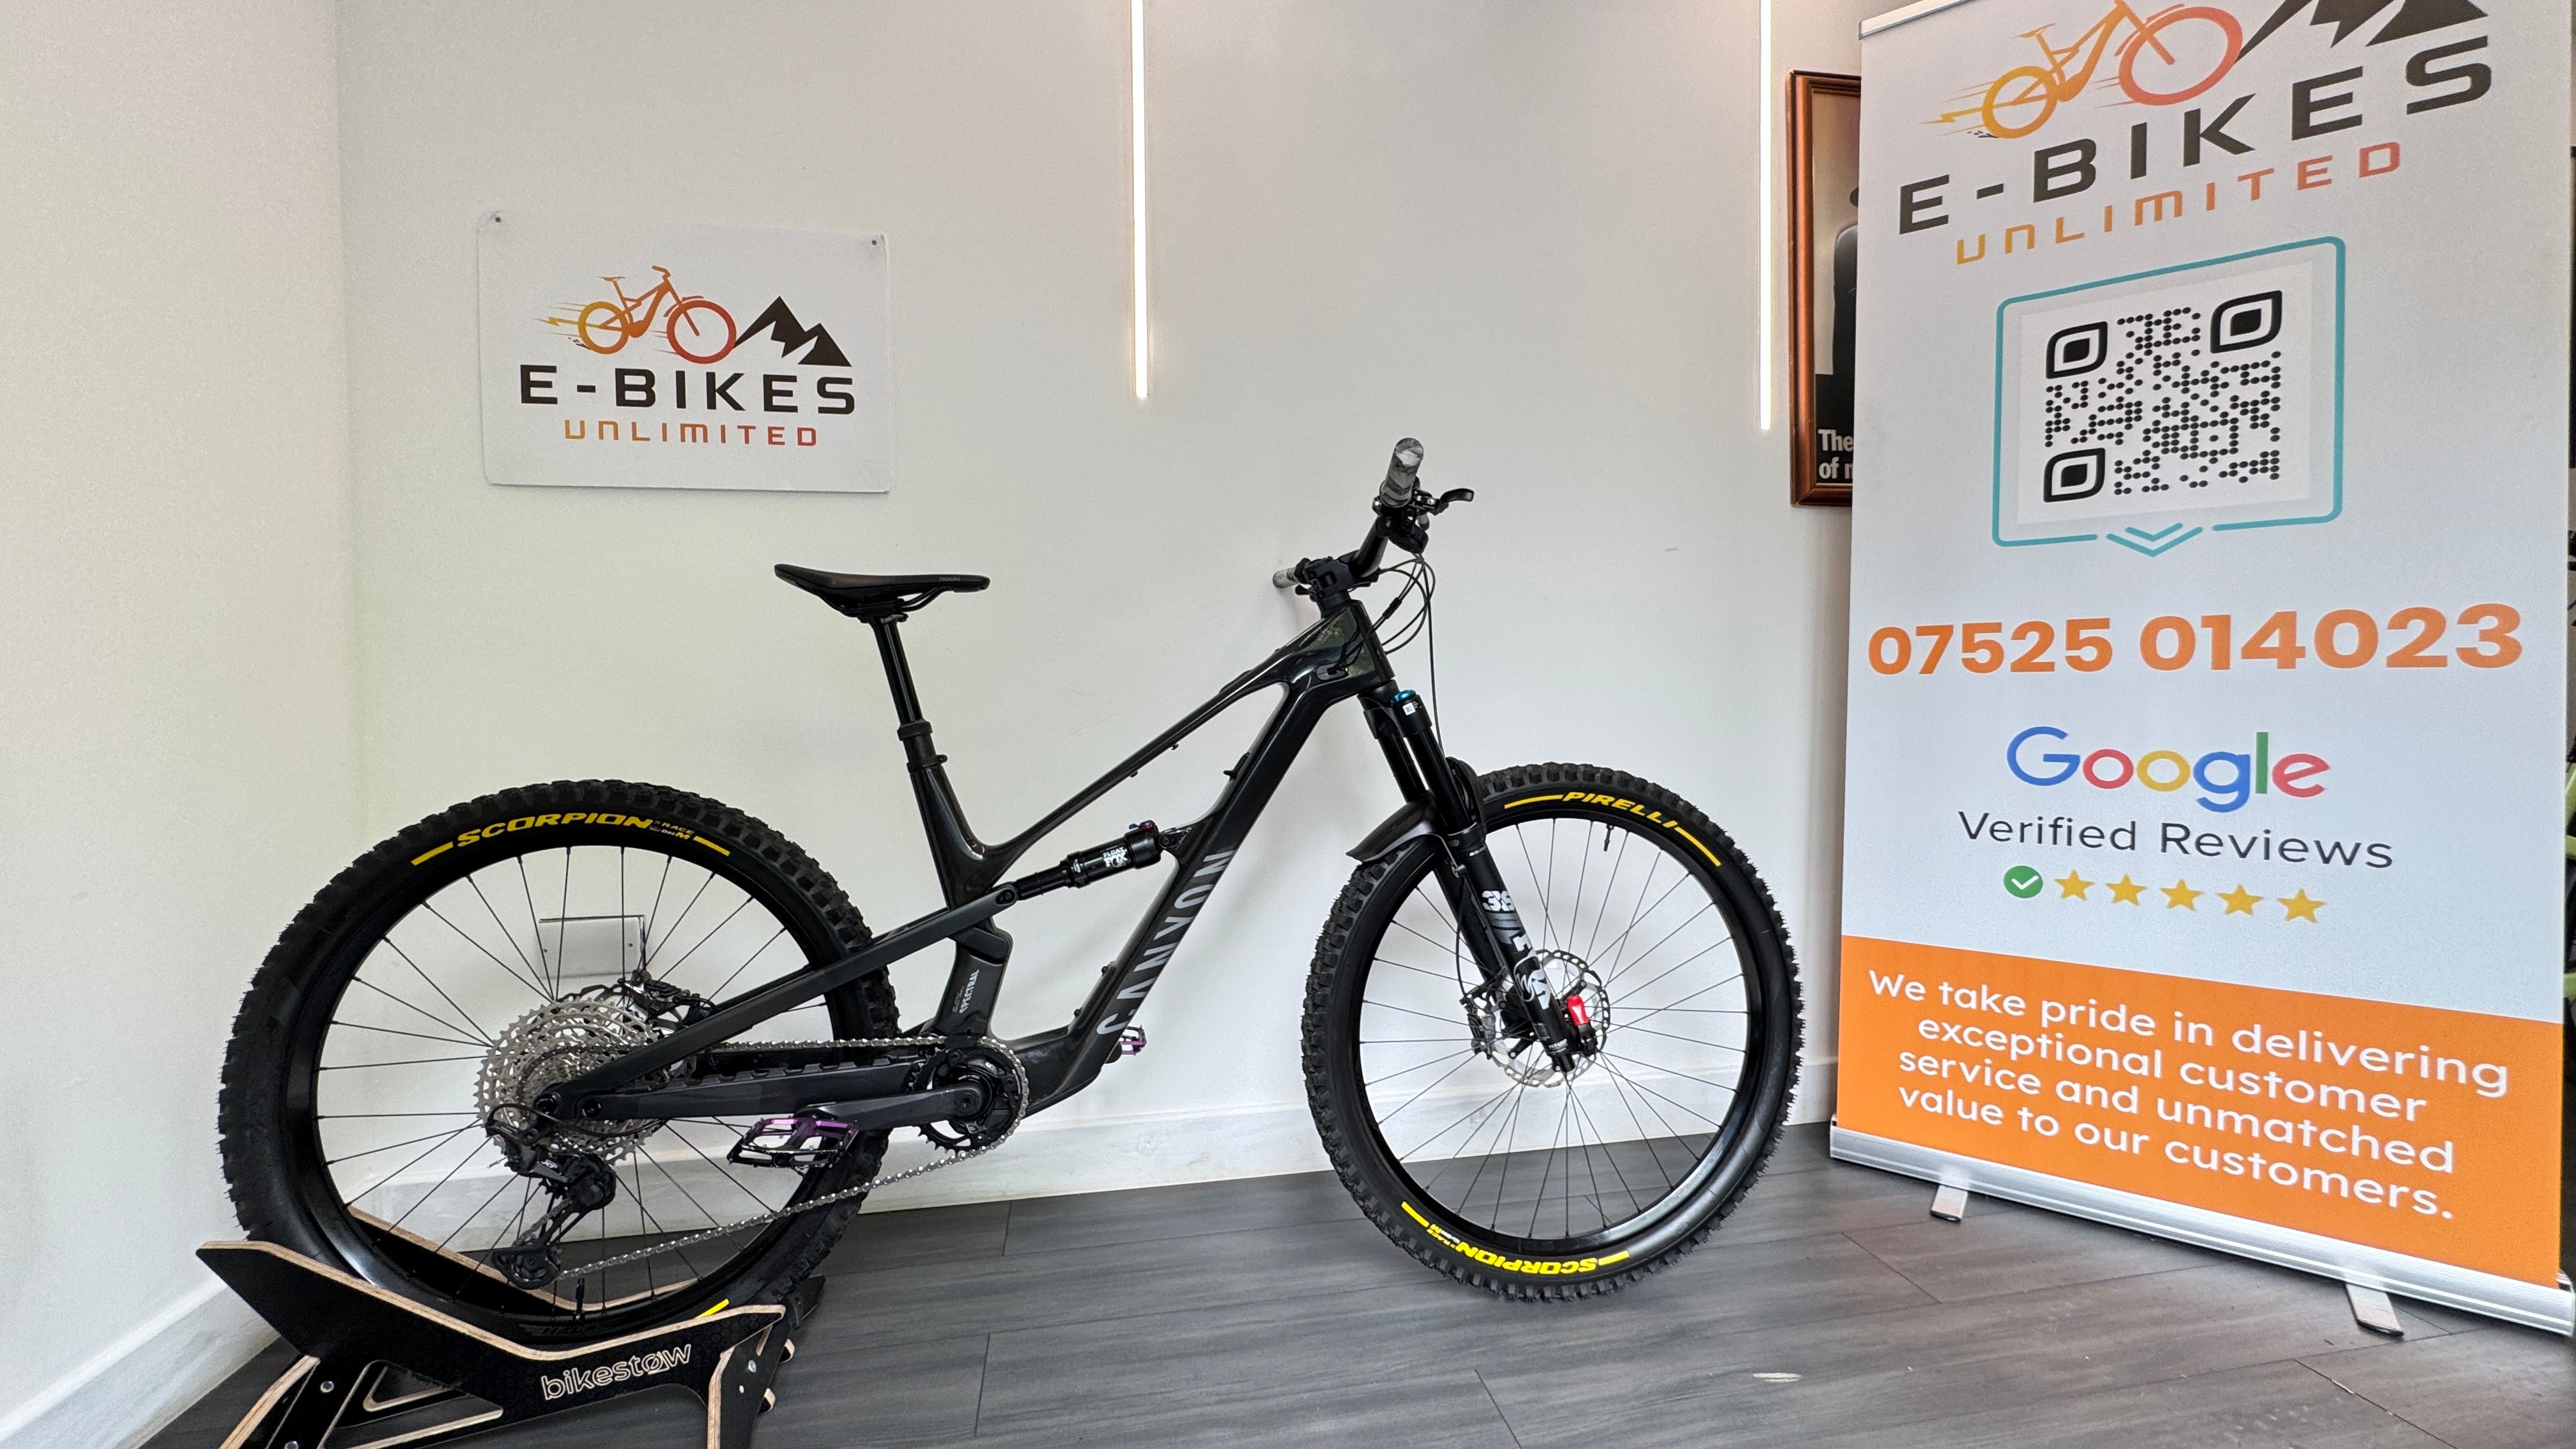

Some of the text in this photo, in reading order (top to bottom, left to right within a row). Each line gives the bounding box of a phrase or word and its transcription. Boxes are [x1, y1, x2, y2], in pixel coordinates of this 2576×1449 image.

[1899, 35, 2492, 234] E-BIKES
[1956, 142, 2400, 264] UNLIMITED
[520, 364, 855, 415] E-BIKES
[564, 420, 817, 447] UNLIMITED
[1818, 429, 1853, 452] The
[1818, 456, 1840, 479] of
[1868, 603, 2522, 675] 07525 014023
[2006, 726, 2329, 813] Google
[457, 812, 653, 847] SCORPION
[1563, 792, 1678, 829] PIRELLI
[1103, 852, 1128, 868] FOX
[1958, 811, 2393, 869] Verified Reviews
[959, 969, 980, 1014] SPECTRAL
[1869, 970, 2508, 1100] We take pride in delivering
[1918, 1015, 2427, 1122] exceptional customer
[1899, 1050, 2455, 1174] service and unmatched
[1899, 1087, 2454, 1219] value to our customers.
[1455, 1241, 1597, 1275] SCORPION
